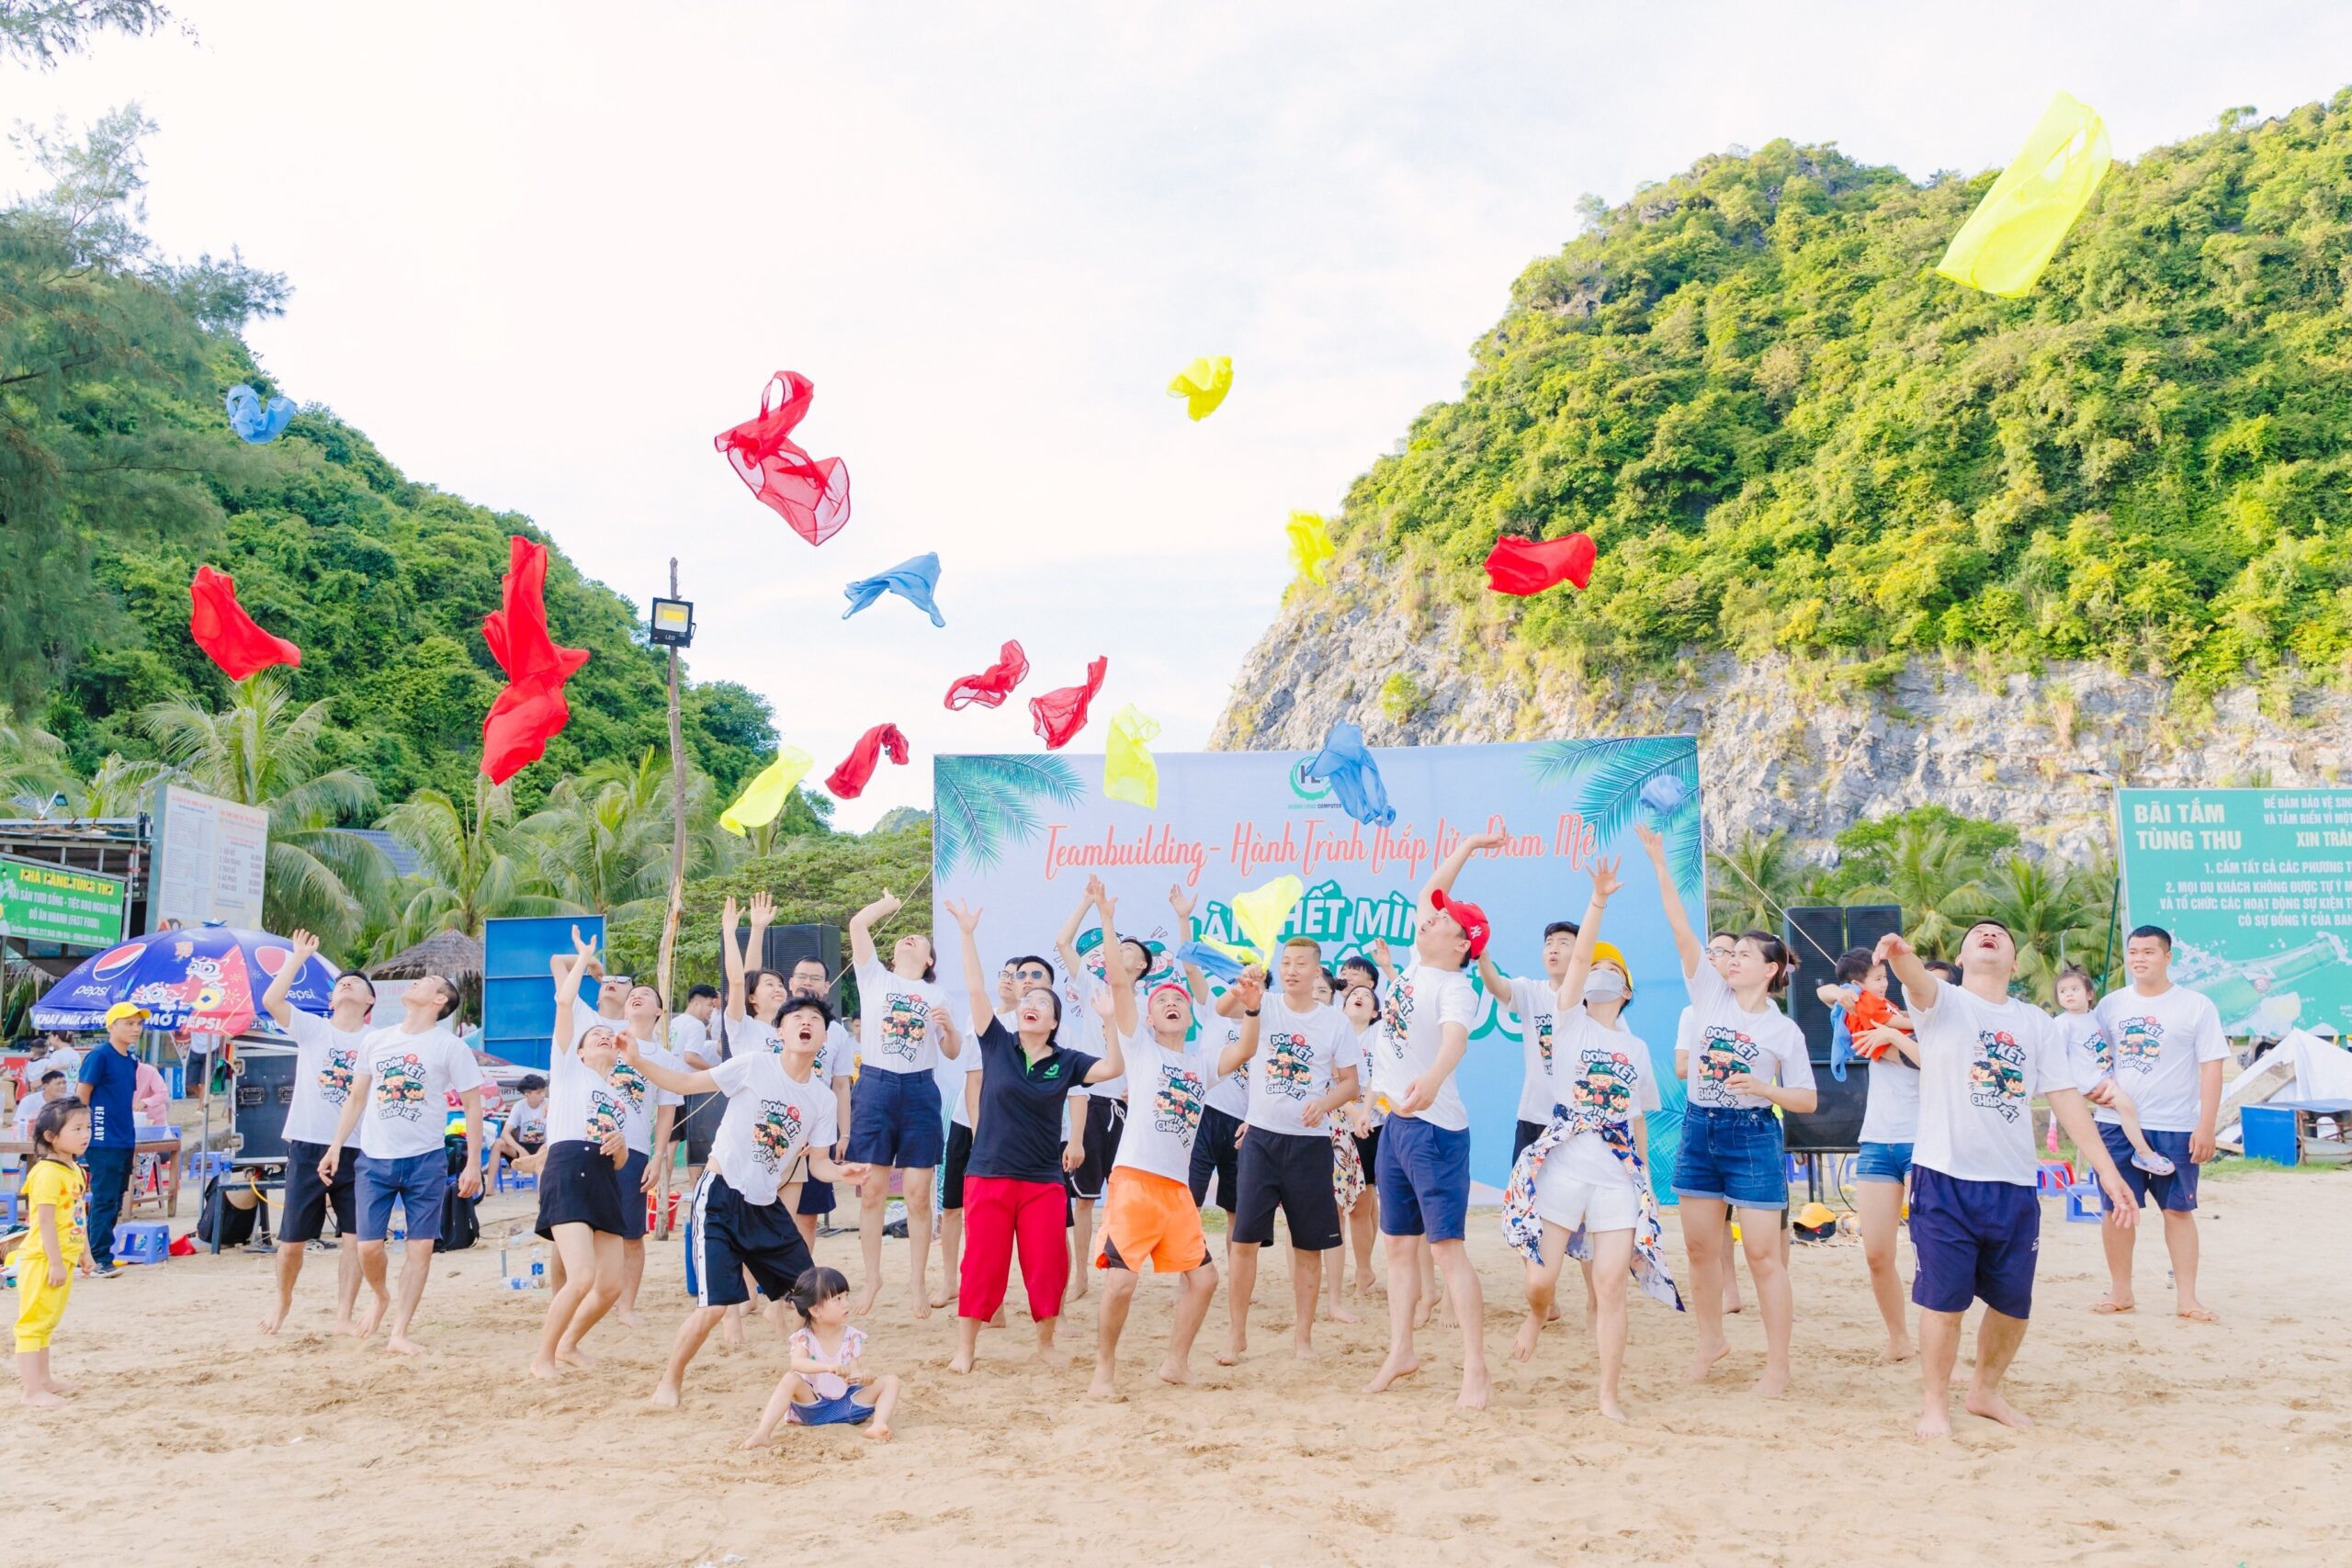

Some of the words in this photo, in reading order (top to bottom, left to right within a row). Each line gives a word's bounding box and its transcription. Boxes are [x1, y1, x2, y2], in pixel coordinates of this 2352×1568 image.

[2134, 801, 2171, 823] BÃI
[2177, 797, 2225, 823] TẮM
[2301, 794, 2320, 808] BẢO
[2322, 795, 2334, 810] VỆ
[2264, 811, 2276, 825] VÀ
[1230, 820, 1301, 876] Hành
[1302, 818, 1369, 876] Trình
[1554, 814, 1599, 872] Mê
[2136, 827, 2194, 850] TÙNG
[2199, 830, 2242, 850] THU
[2296, 831, 2320, 847] XIN
[2205, 862, 2214, 874] 1.
[2216, 859, 2239, 874] CẤM
[2243, 858, 2260, 874] TẤT
[2263, 858, 2277, 874] CẢ
[2279, 860, 2300, 874] CÁC
[2165, 881, 2176, 893] 2.
[2177, 881, 2198, 896] MỌI
[2200, 881, 2214, 893] DU
[2216, 879, 2251, 893] KHÁCH
[2253, 879, 2288, 893] KHÔNG
[2290, 880, 2317, 896] ĐƯỢC
[2320, 880, 2334, 895] TỰ
[2159, 896, 2174, 909] VÀ
[2190, 897, 2218, 909] CHỨC
[2221, 896, 2241, 909] CÁC
[2244, 897, 2269, 912] HOẠT
[2302, 897, 2317, 912] SỰ
[2319, 895, 2344, 912] KIỆN
[2238, 912, 2252, 926] CÓ
[2255, 914, 2268, 929] SỰ
[2311, 910, 2332, 926] CỦA
[73, 985, 111, 998] pepsi
[286, 988, 315, 1001] epsi
[910, 1000, 931, 1016] KẾT
[175, 1015, 221, 1031] PEPSI
[2143, 1023, 2164, 1038] KẾT
[1705, 1026, 1736, 1042] ĐOÀN
[1733, 1039, 1758, 1060] KẾT
[1290, 1044, 1314, 1062] KẾT
[1995, 1043, 2026, 1066] KẾT
[377, 1055, 404, 1072] ĐOÀN
[401, 1063, 425, 1080] KẾT
[1581, 1048, 1613, 1064] ĐOÀN
[1611, 1061, 1637, 1084] KẾT
[762, 1100, 787, 1116] ĐOÀN
